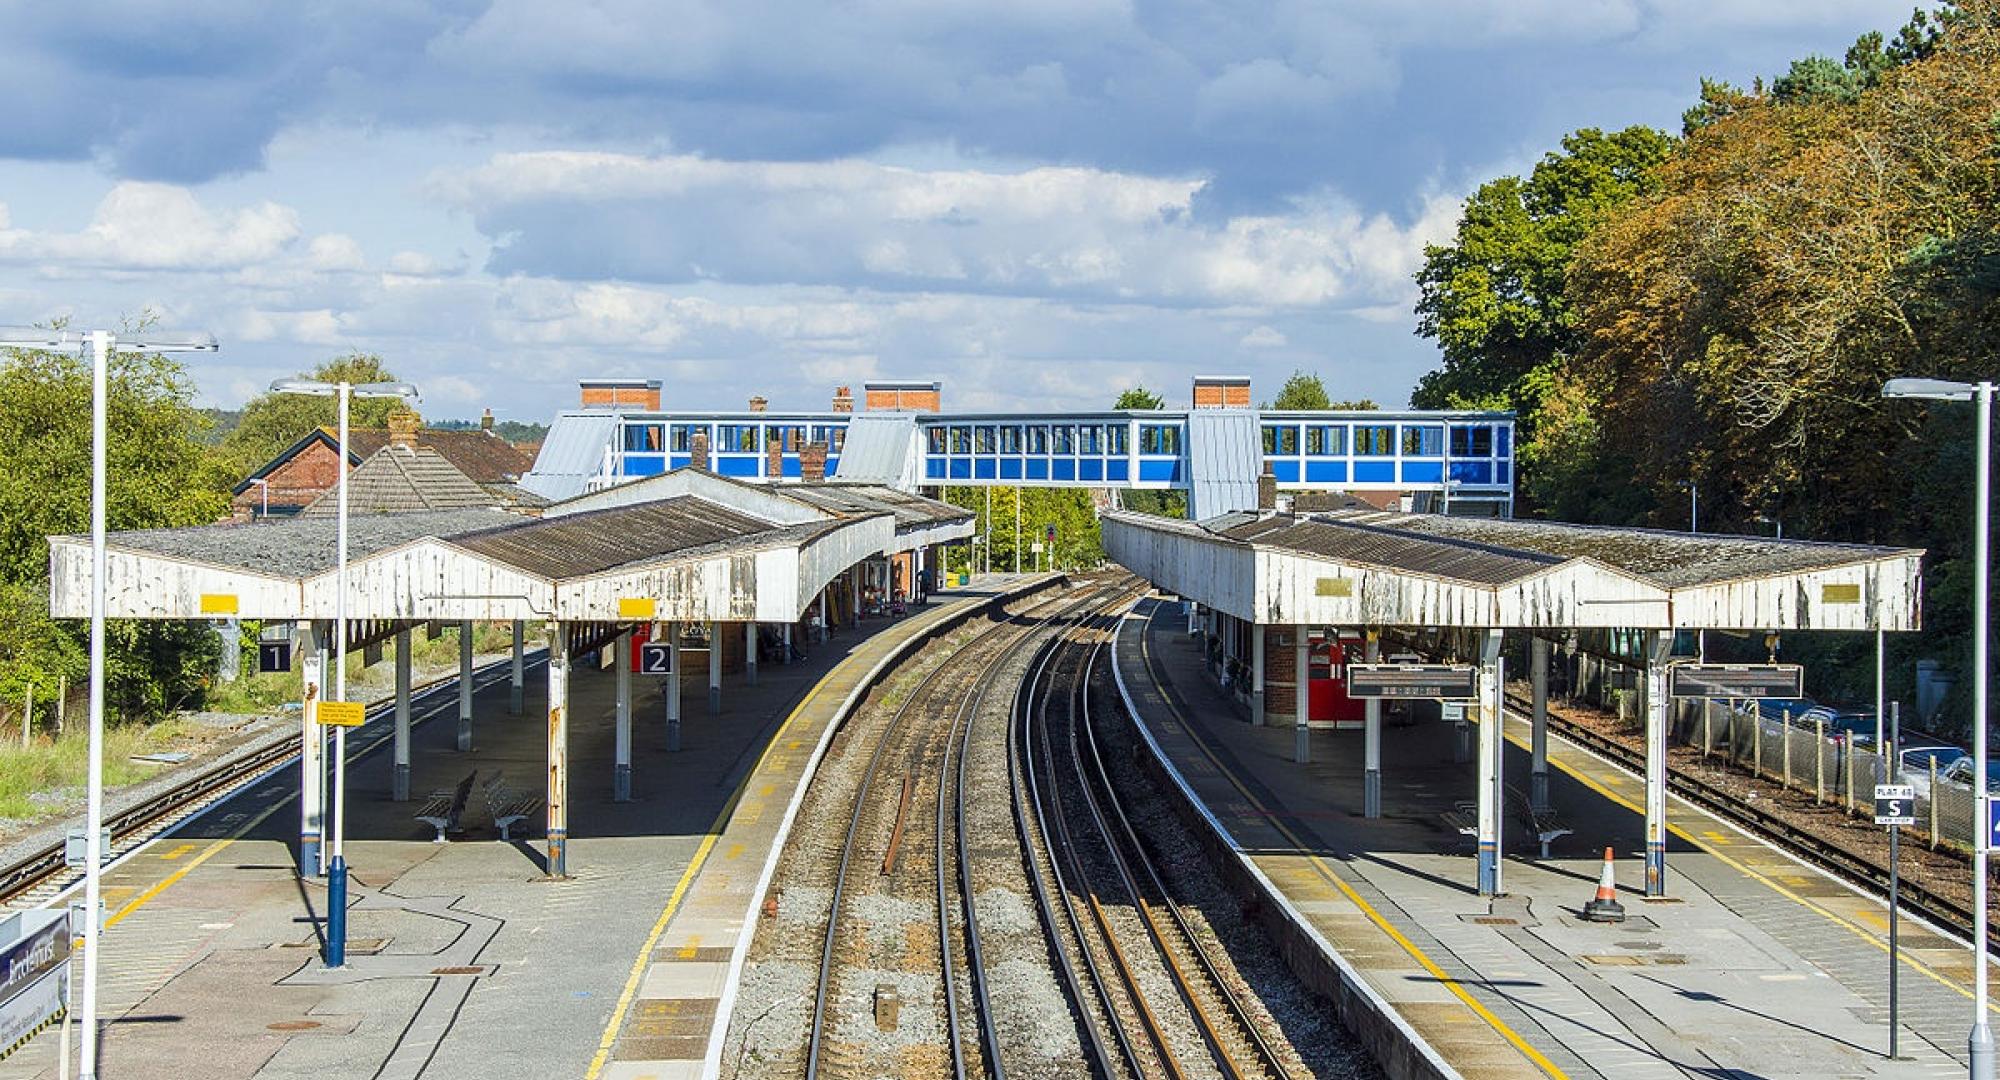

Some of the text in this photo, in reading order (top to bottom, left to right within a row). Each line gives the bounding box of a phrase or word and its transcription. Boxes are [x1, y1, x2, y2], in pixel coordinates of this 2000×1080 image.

[269, 647, 279, 670] 1
[649, 649, 667, 671] 2
[1888, 800, 1901, 816] S
